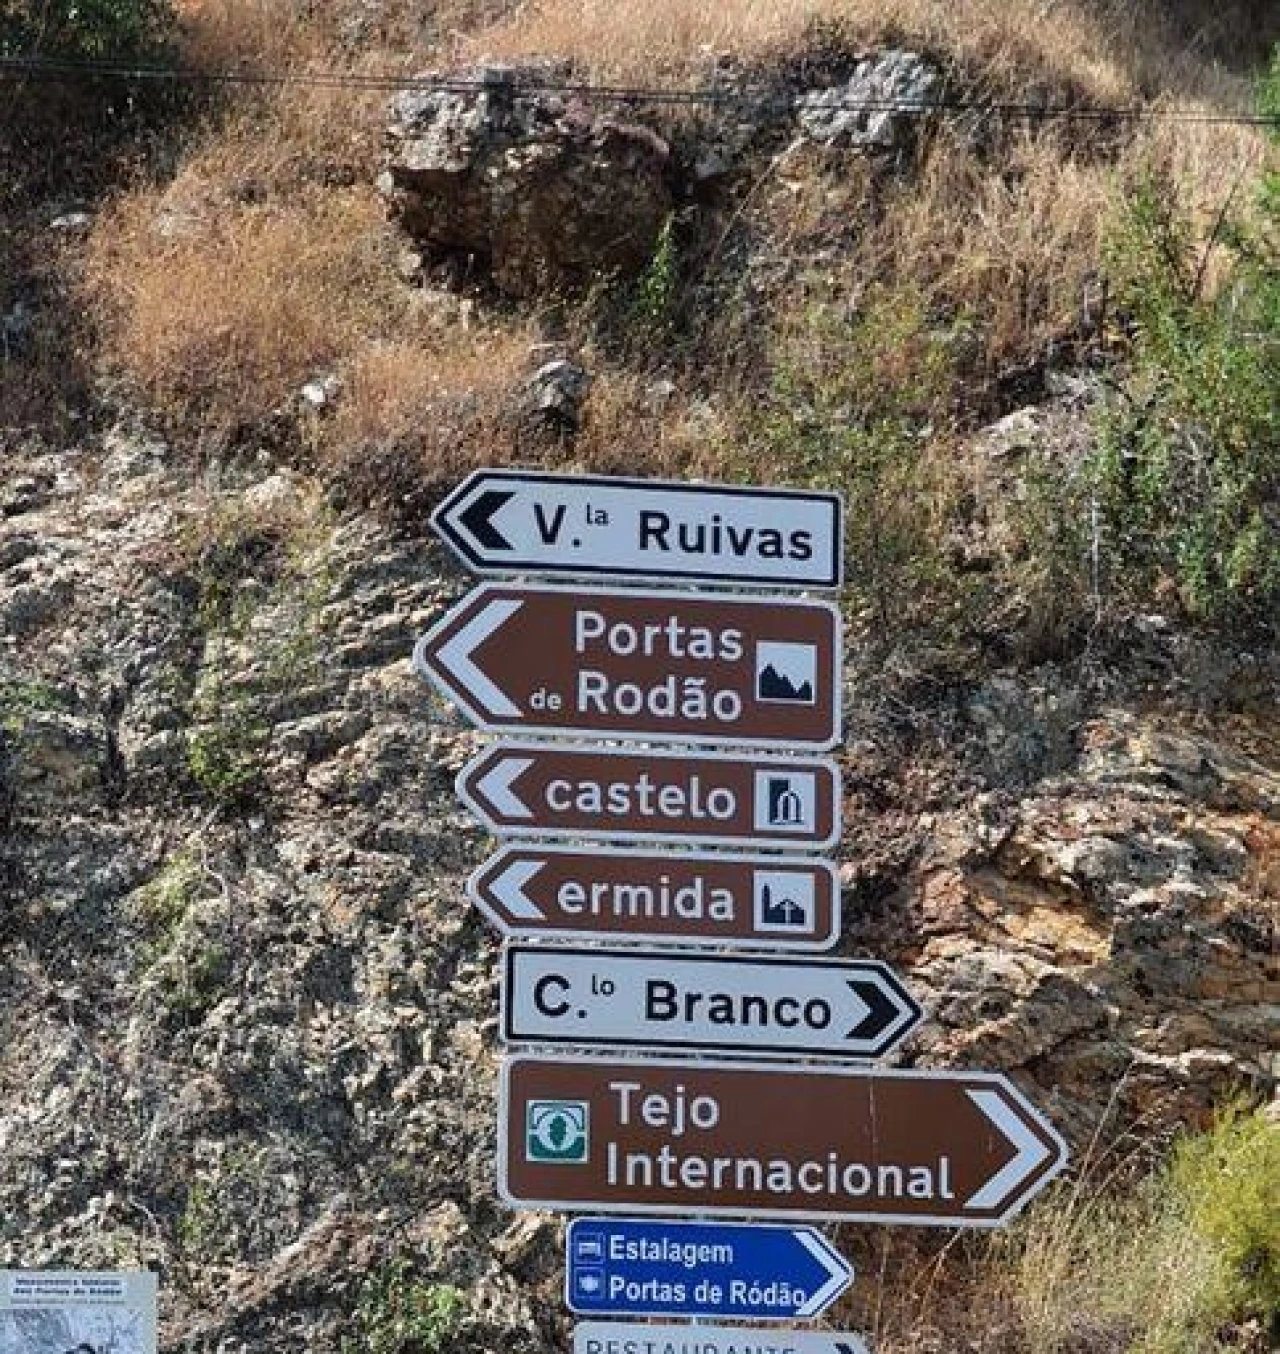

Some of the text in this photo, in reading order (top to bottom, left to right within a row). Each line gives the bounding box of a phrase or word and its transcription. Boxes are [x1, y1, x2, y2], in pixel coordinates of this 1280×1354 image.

[638, 511, 813, 560] Ruivas
[574, 610, 744, 662] Portas
[529, 671, 742, 722] de Rodão
[545, 776, 736, 819] castelo
[557, 875, 734, 922] ermida
[645, 979, 832, 1030] Branco
[609, 1081, 720, 1135] Tejo
[607, 1143, 954, 1200] Internacional
[609, 1234, 733, 1268] Estalagem
[609, 1275, 805, 1308] Portas de Ródão
